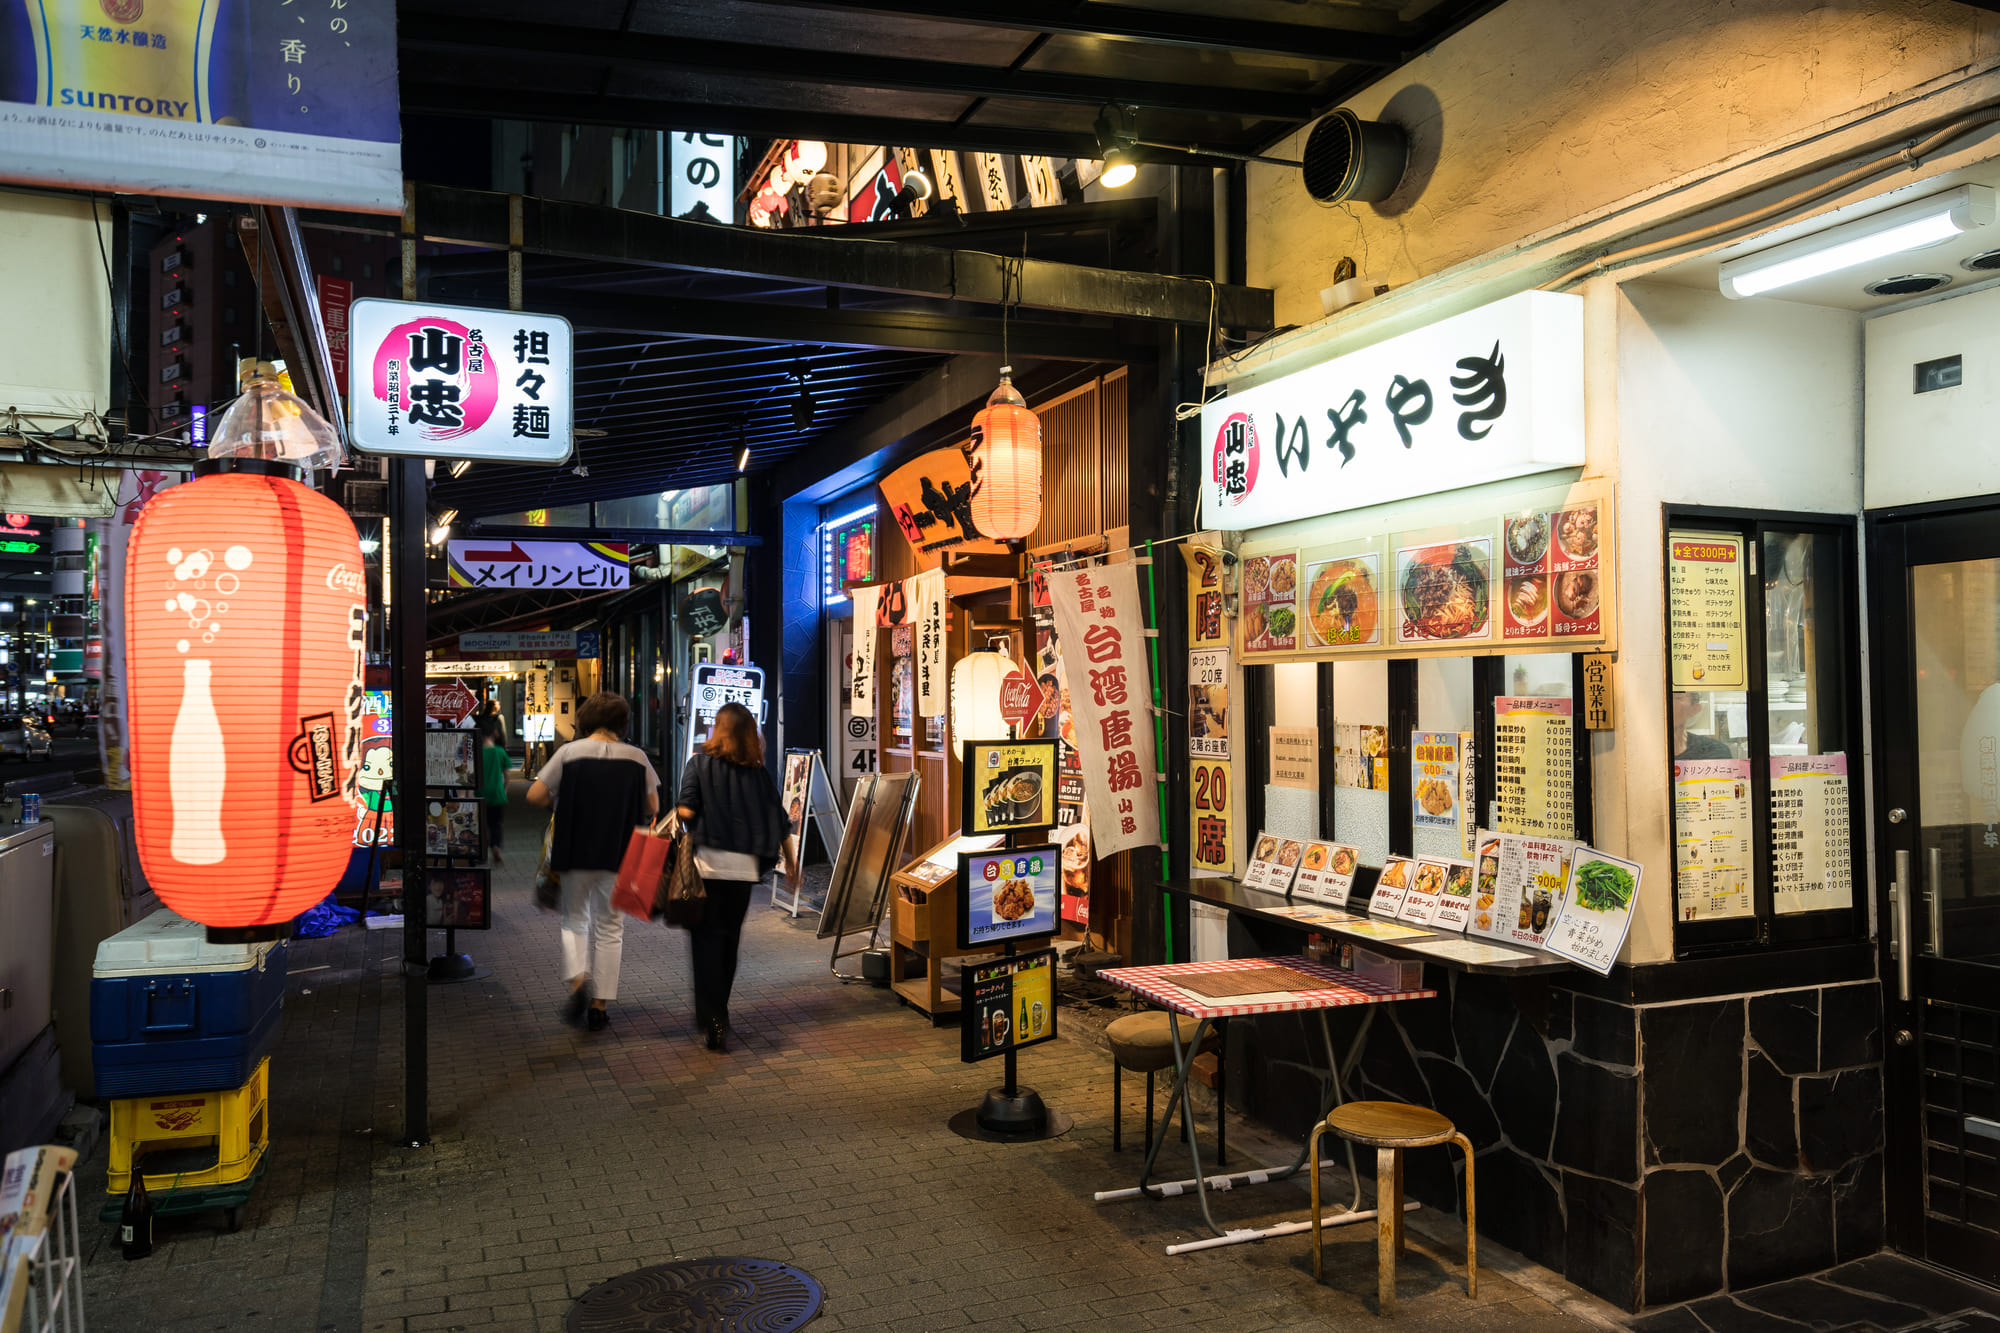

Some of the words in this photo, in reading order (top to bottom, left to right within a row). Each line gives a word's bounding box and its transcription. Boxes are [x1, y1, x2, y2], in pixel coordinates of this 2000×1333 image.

[80, 24, 168, 51] 天然水醸造
[60, 87, 190, 118] SUNTORY
[468, 328, 483, 373] 名古屋
[408, 327, 464, 427] 山忠
[513, 328, 550, 439] 担々麺
[1226, 421, 1246, 497] 山忠
[1554, 559, 1598, 572] 海鮮ラーメン
[476, 564, 623, 587] メイリンビル
[1076, 573, 1096, 613] 名古屋
[1097, 586, 1115, 618] 名物
[1327, 625, 1360, 643] 担々麺
[1402, 616, 1484, 639] 台湾ラーメン
[1555, 621, 1599, 633] 豚骨ラーメン
[1192, 656, 1217, 668] ゆったり
[1201, 668, 1222, 683] 20席
[1585, 659, 1607, 728] 営業中
[1084, 624, 1141, 792] 台湾唐揚
[1506, 700, 1560, 709] 一品料理メニュー
[1191, 737, 1227, 752] 2階お座敷
[1008, 757, 1042, 765] 台湾ラーメン
[1781, 763, 1836, 772] 一品料理メニュー
[1683, 766, 1739, 775] ドリンクメニュー
[1521, 841, 1563, 853] 小皿料理2品と
[1526, 851, 1555, 862] 飲物1杯で
[986, 860, 1041, 878] 台湾唐揚
[1537, 875, 1561, 889] 900円
[1571, 942, 1610, 965] 始めました
